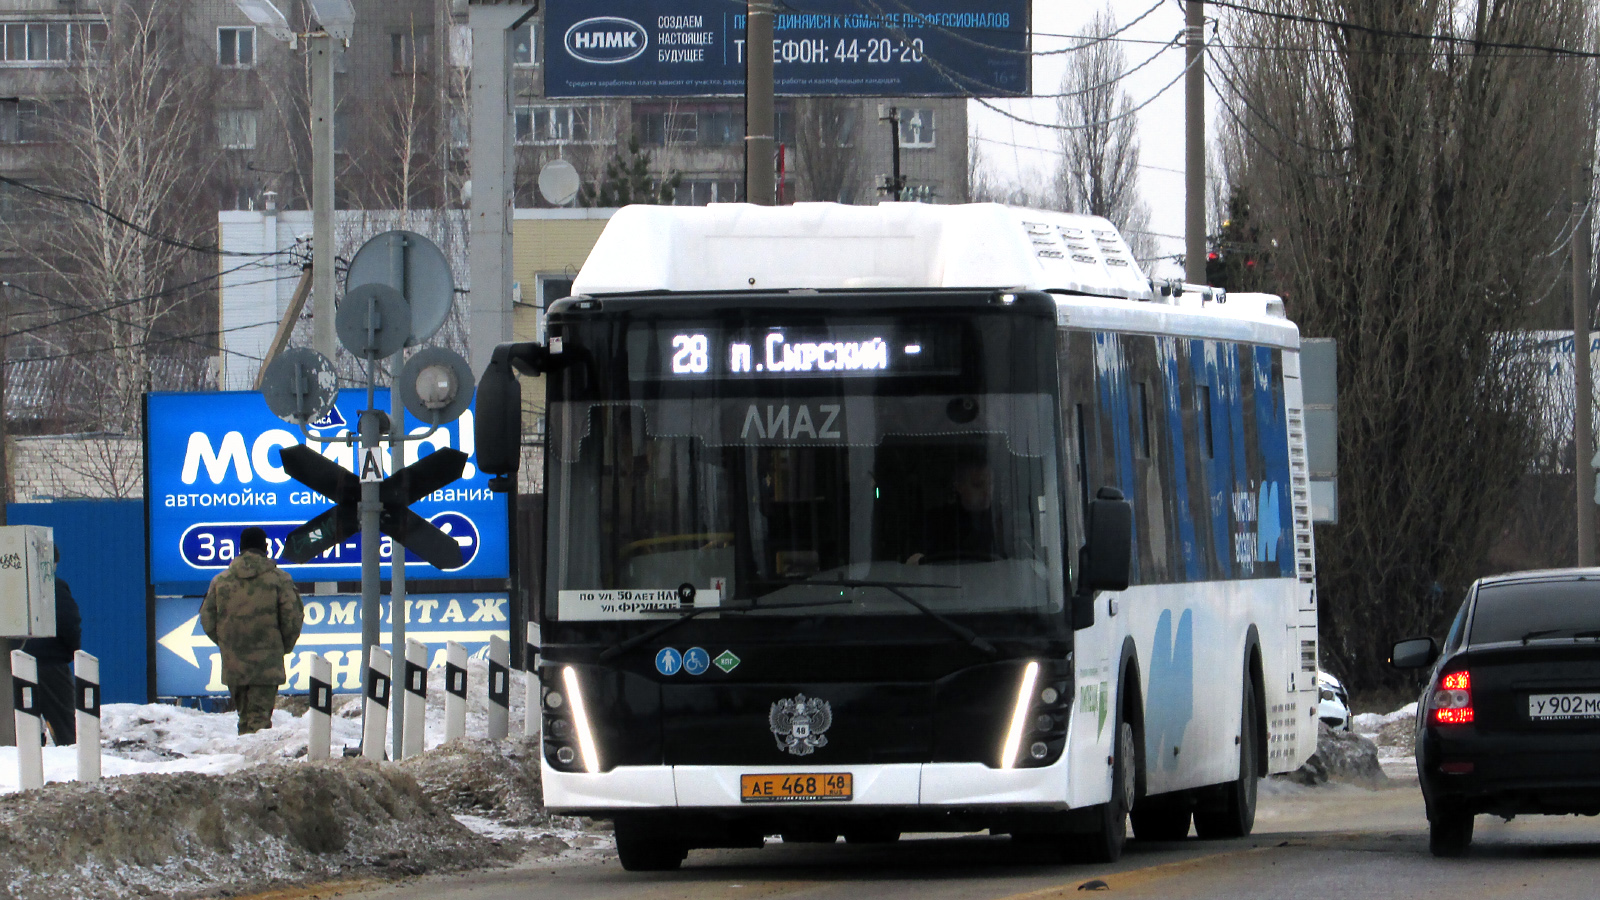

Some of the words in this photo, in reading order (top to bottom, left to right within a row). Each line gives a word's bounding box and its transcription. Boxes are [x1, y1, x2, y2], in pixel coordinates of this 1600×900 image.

[658, 15, 703, 29] СОЗДАЕМ
[833, 15, 841, 28] К
[903, 12, 1010, 29] ПРОФЕССИОНАЛОВ
[575, 31, 637, 48] НЛМК
[658, 32, 713, 46] НАСТОЯЩЕЕ
[658, 49, 704, 63] БУДУЩЕЕ
[733, 38, 829, 63] ТЕФОН:
[834, 37, 923, 63] 44-20-20
[673, 334, 708, 373] 28
[361, 449, 382, 480] А
[165, 488, 277, 508] автомойка
[617, 591, 632, 601] 50
[781, 777, 817, 795] 468
[827, 775, 846, 789] 48
